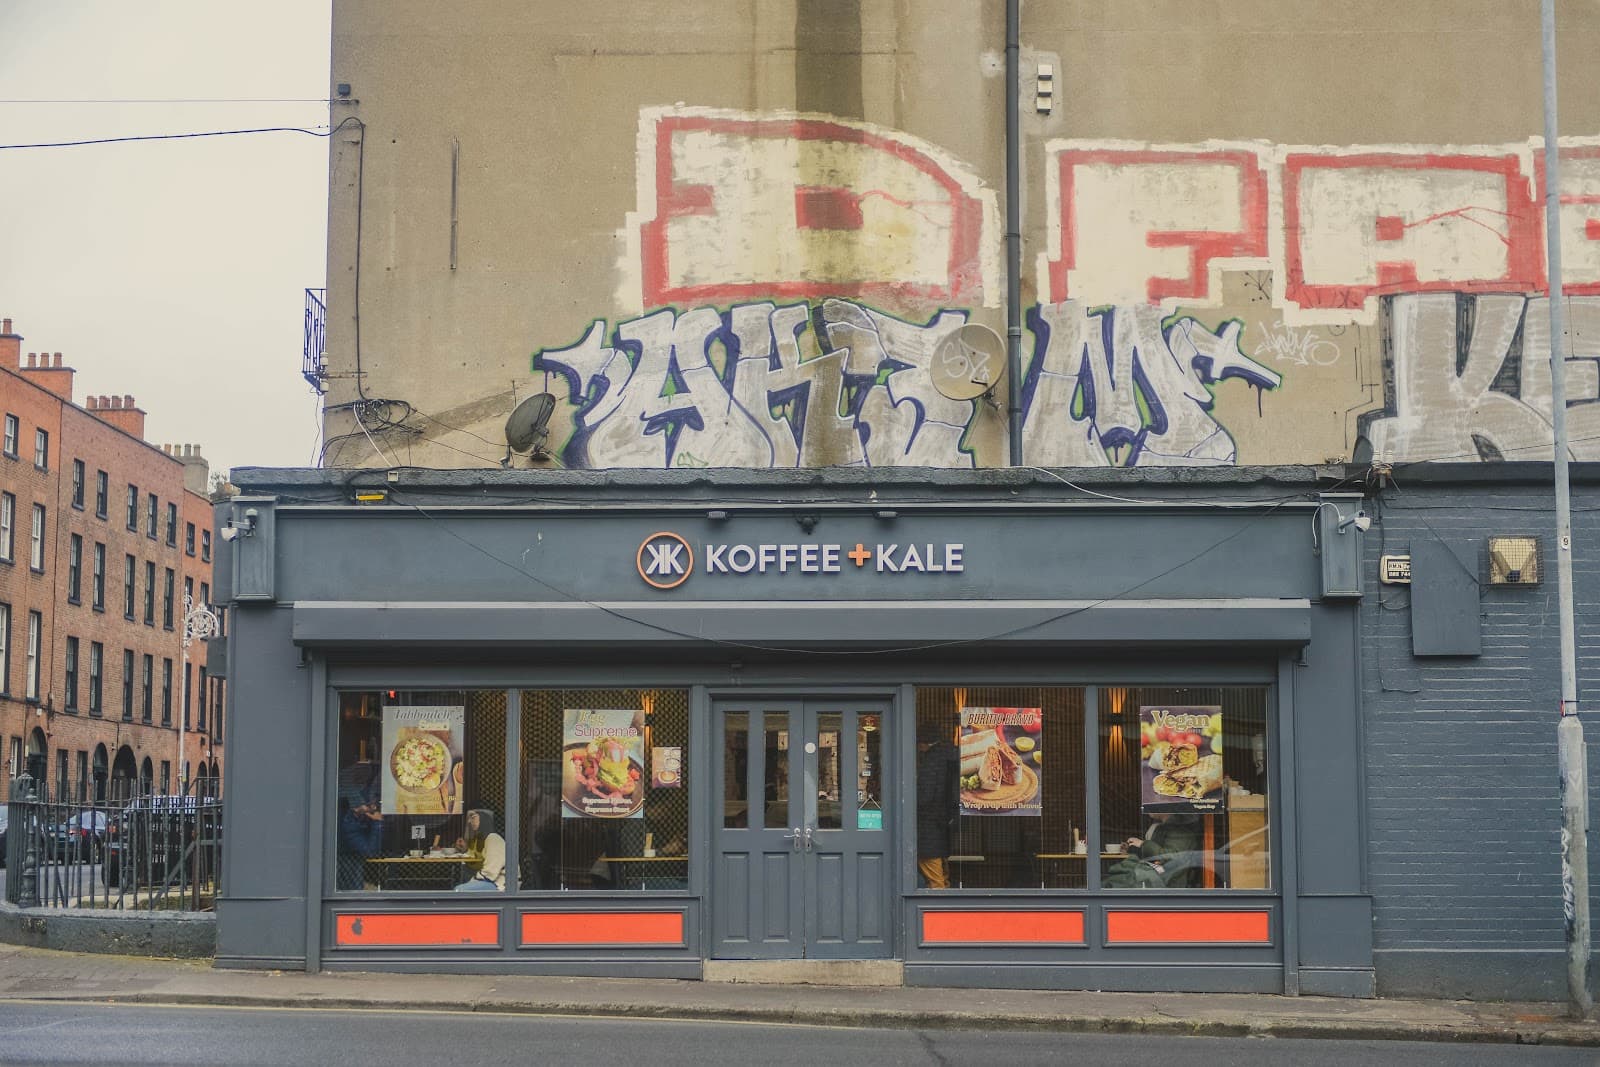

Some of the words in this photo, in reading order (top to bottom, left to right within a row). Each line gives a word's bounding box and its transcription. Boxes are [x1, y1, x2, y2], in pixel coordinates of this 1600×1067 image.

[706, 544, 841, 573] KOFFEE
[876, 543, 964, 573] KALE
[575, 723, 638, 738] Supreme
[1151, 710, 1210, 732] Vegan
